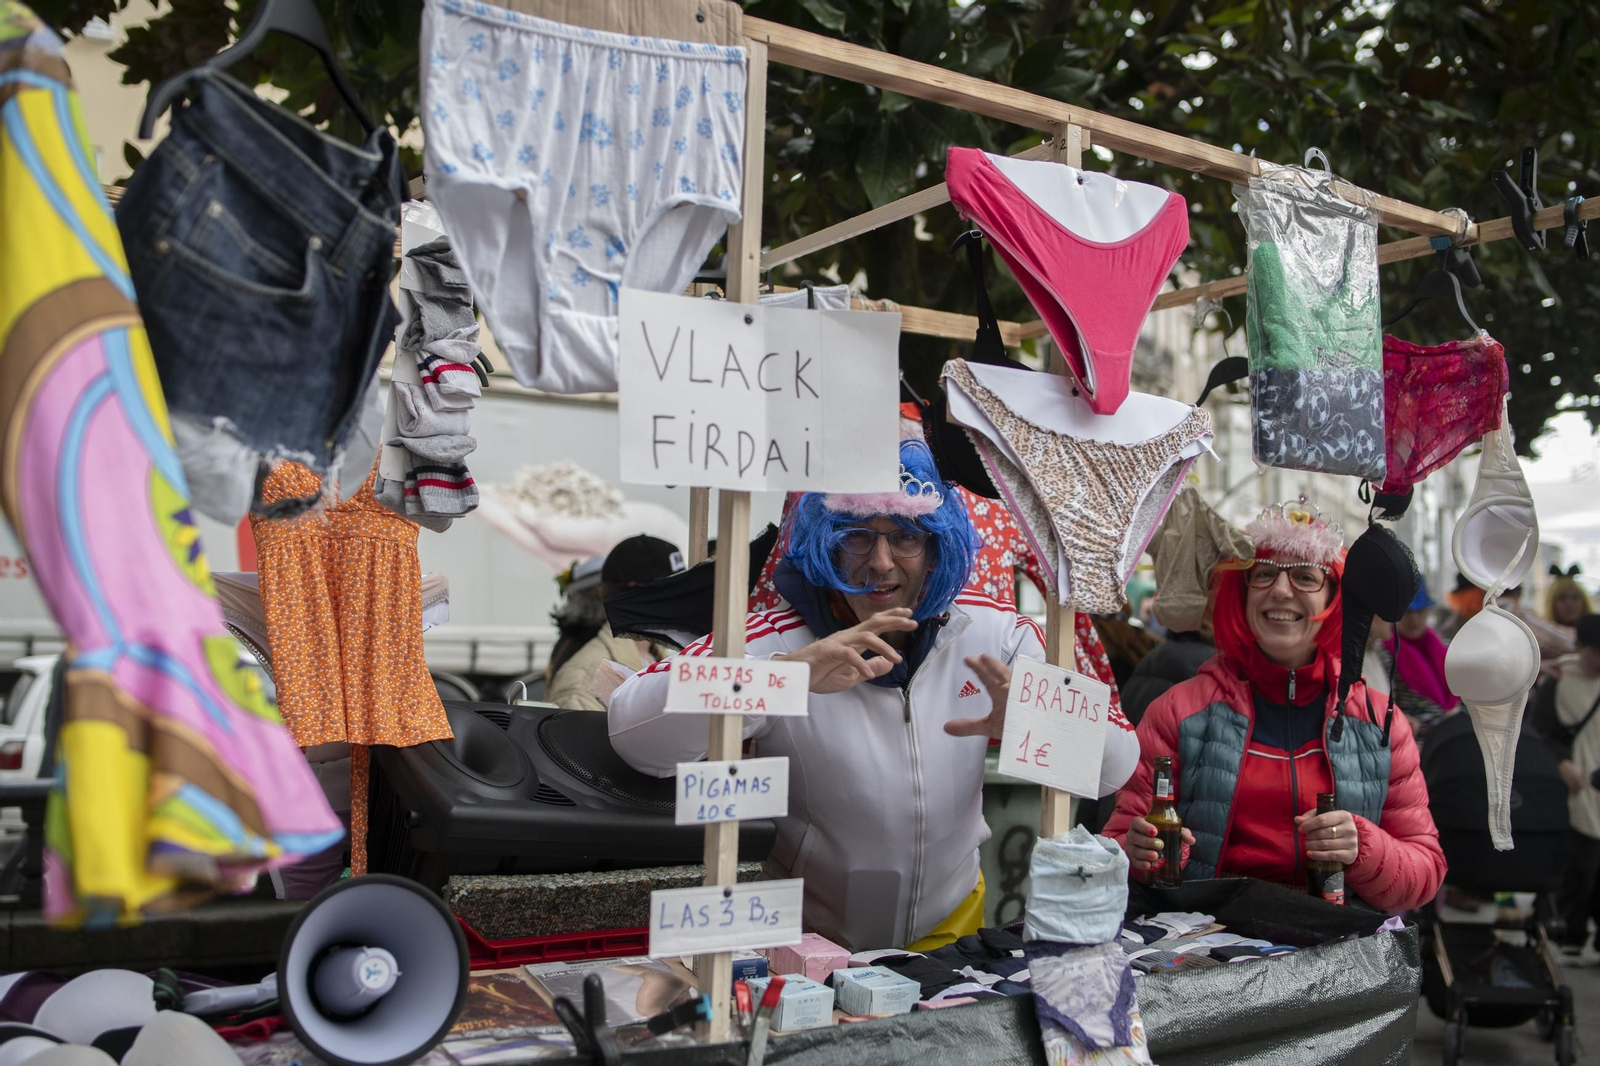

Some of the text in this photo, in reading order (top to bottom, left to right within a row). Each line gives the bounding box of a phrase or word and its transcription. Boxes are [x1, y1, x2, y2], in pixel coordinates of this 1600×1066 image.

[641, 321, 819, 399] VLACK
[678, 662, 787, 688] BRAJAS DE
[699, 693, 766, 711] TOLOSA
[958, 688, 981, 698] adidas
[1019, 671, 1101, 723] BRAJAS
[659, 902, 710, 930] LAS
[718, 899, 735, 927] 3
